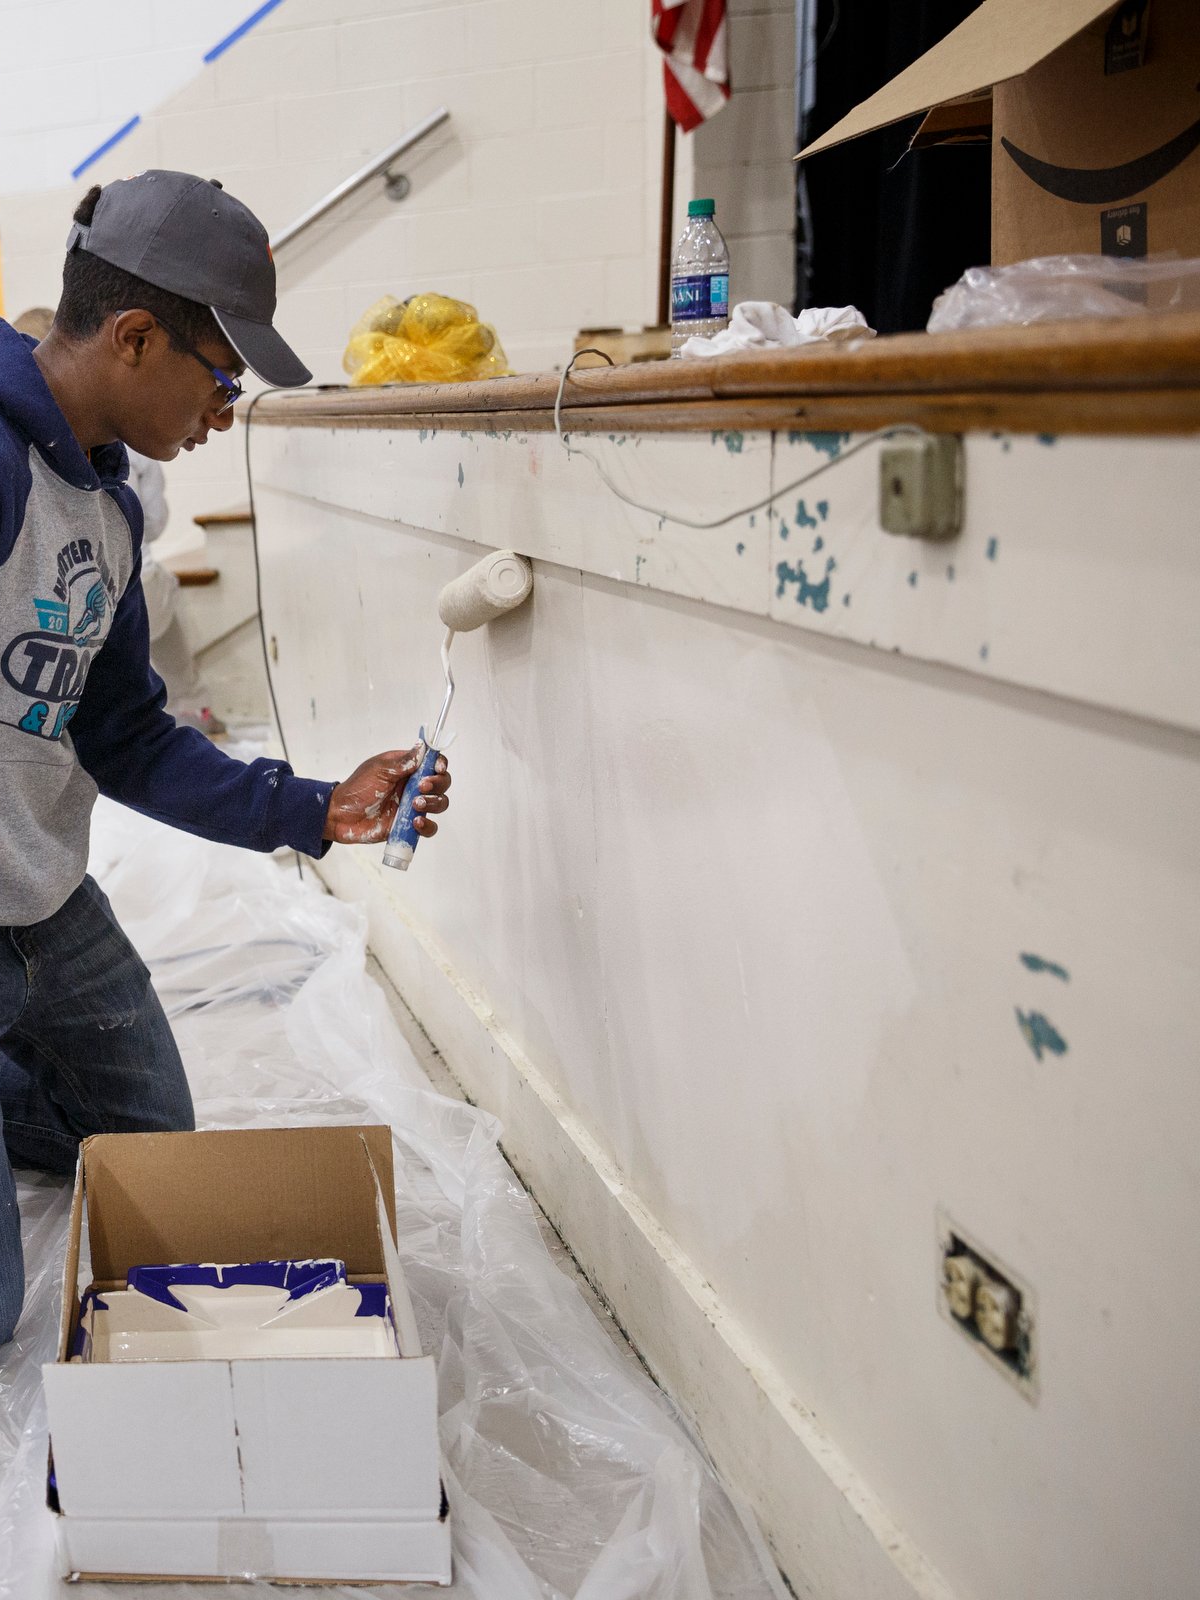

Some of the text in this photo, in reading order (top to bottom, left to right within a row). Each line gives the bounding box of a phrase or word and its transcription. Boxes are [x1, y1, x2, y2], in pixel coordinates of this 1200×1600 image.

[48, 616, 63, 631] 20
[21, 641, 91, 697] TRA
[19, 701, 49, 732] &
